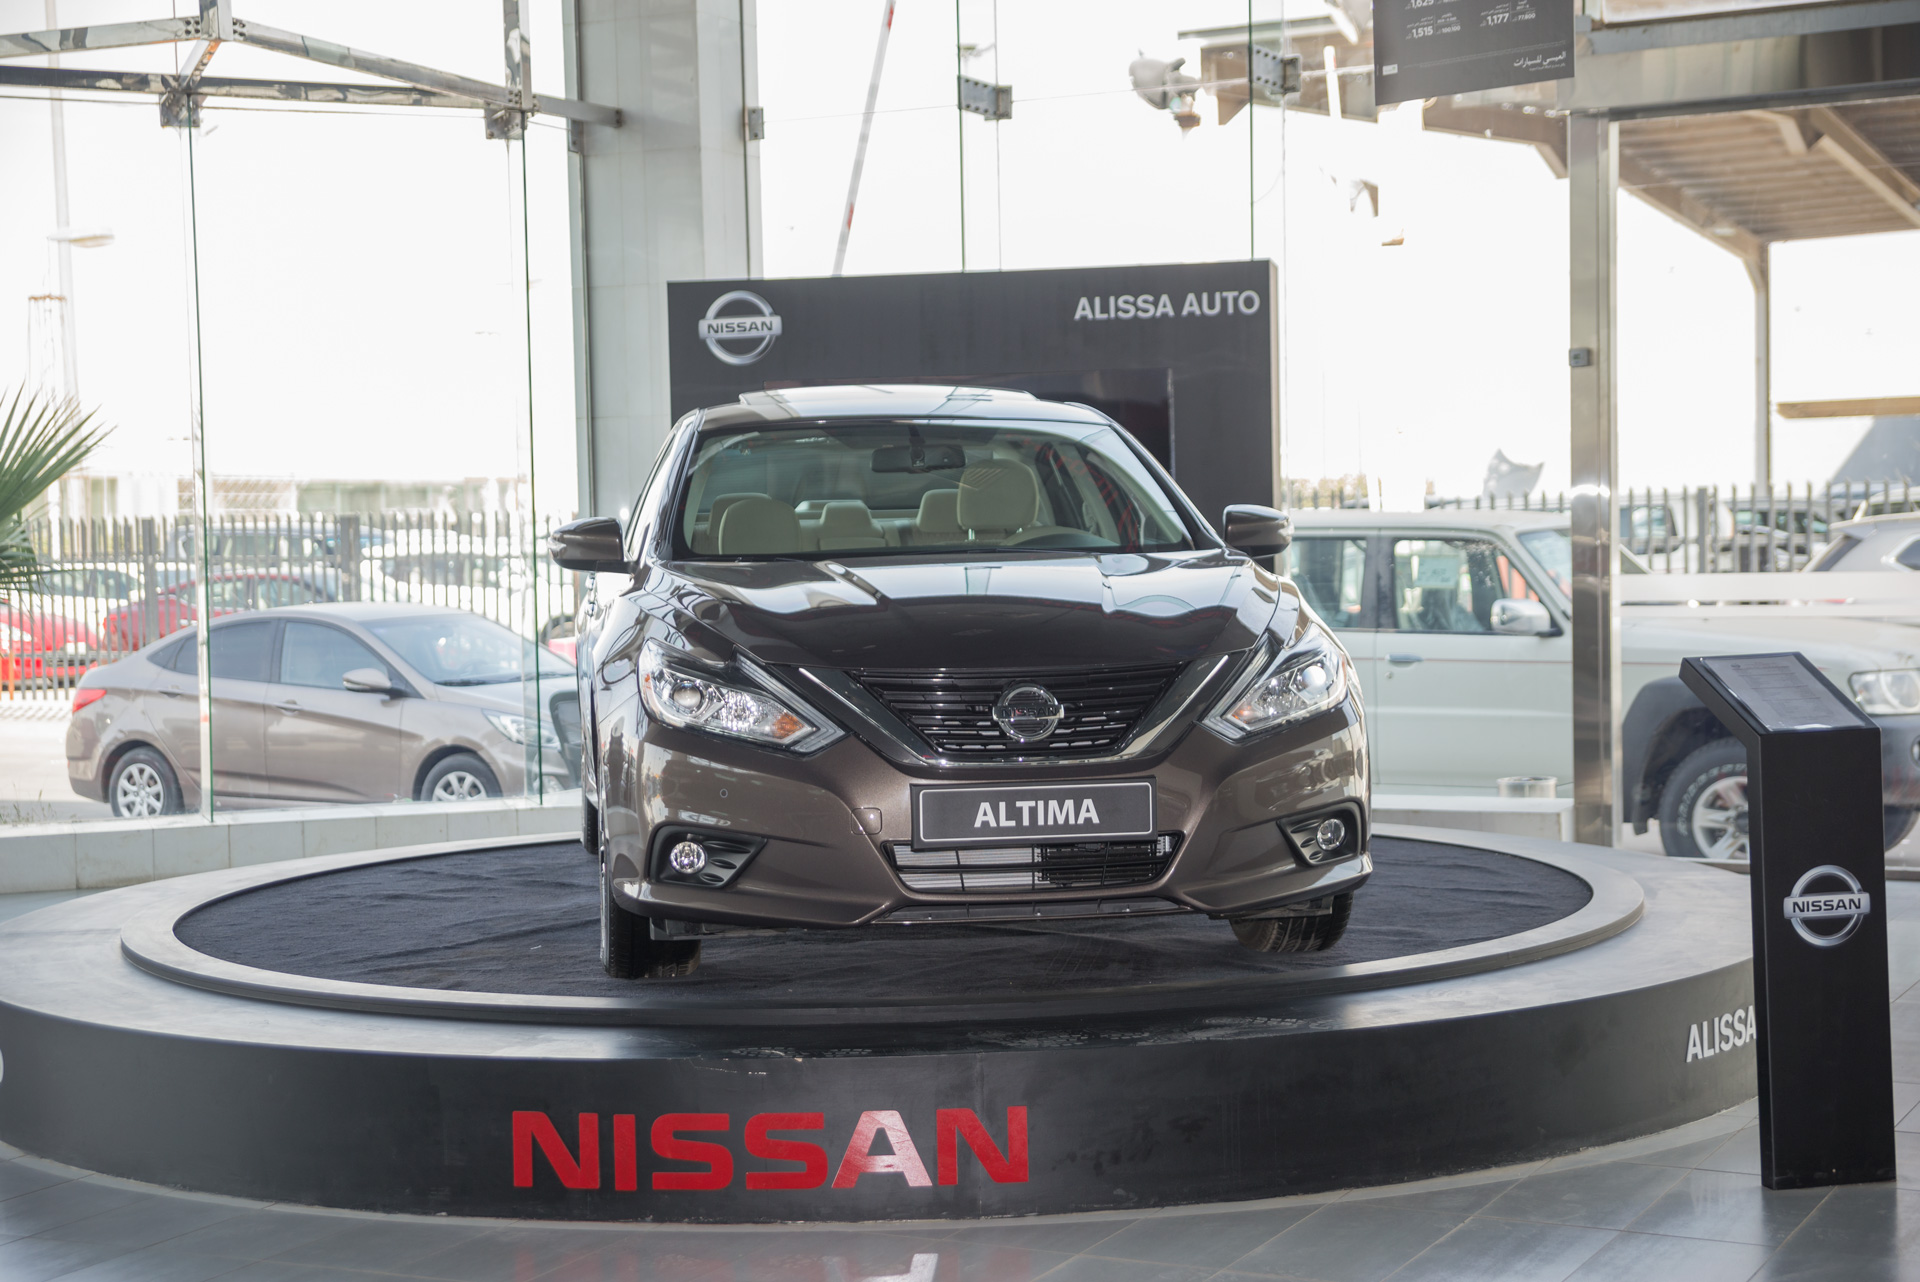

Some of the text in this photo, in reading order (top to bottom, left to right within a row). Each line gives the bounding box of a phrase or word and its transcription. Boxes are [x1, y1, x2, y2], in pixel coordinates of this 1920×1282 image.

[1486, 13, 1509, 26] 1,177
[1411, 26, 1433, 39] 1,515
[1073, 290, 1261, 321] ALISSA AUTO
[707, 320, 773, 334] NISSAN
[1002, 707, 1057, 718] NISSAN
[973, 798, 1100, 828] ALTIMA
[1792, 898, 1861, 914] NISSAN
[1686, 1005, 1757, 1063] ALISSA
[512, 1105, 1029, 1192] NISSAN
